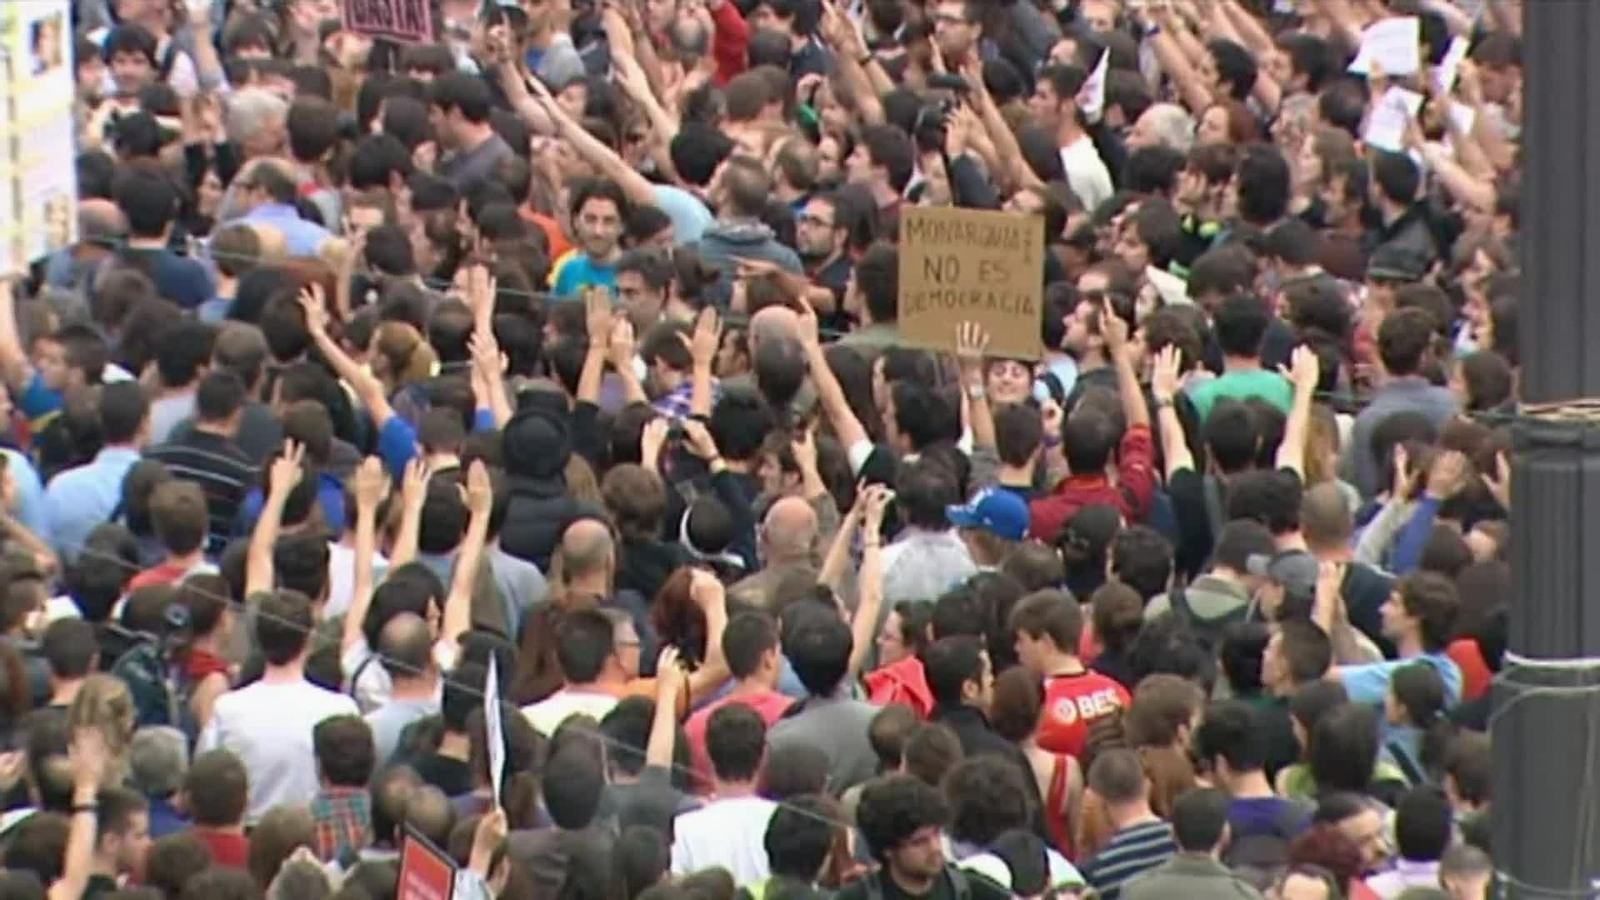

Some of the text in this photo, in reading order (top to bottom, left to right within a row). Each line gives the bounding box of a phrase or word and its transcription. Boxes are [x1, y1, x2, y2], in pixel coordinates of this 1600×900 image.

[906, 217, 1020, 249] MONARQUIA
[923, 254, 1011, 284] NO ES
[904, 287, 1035, 317] DEMOCRACIA
